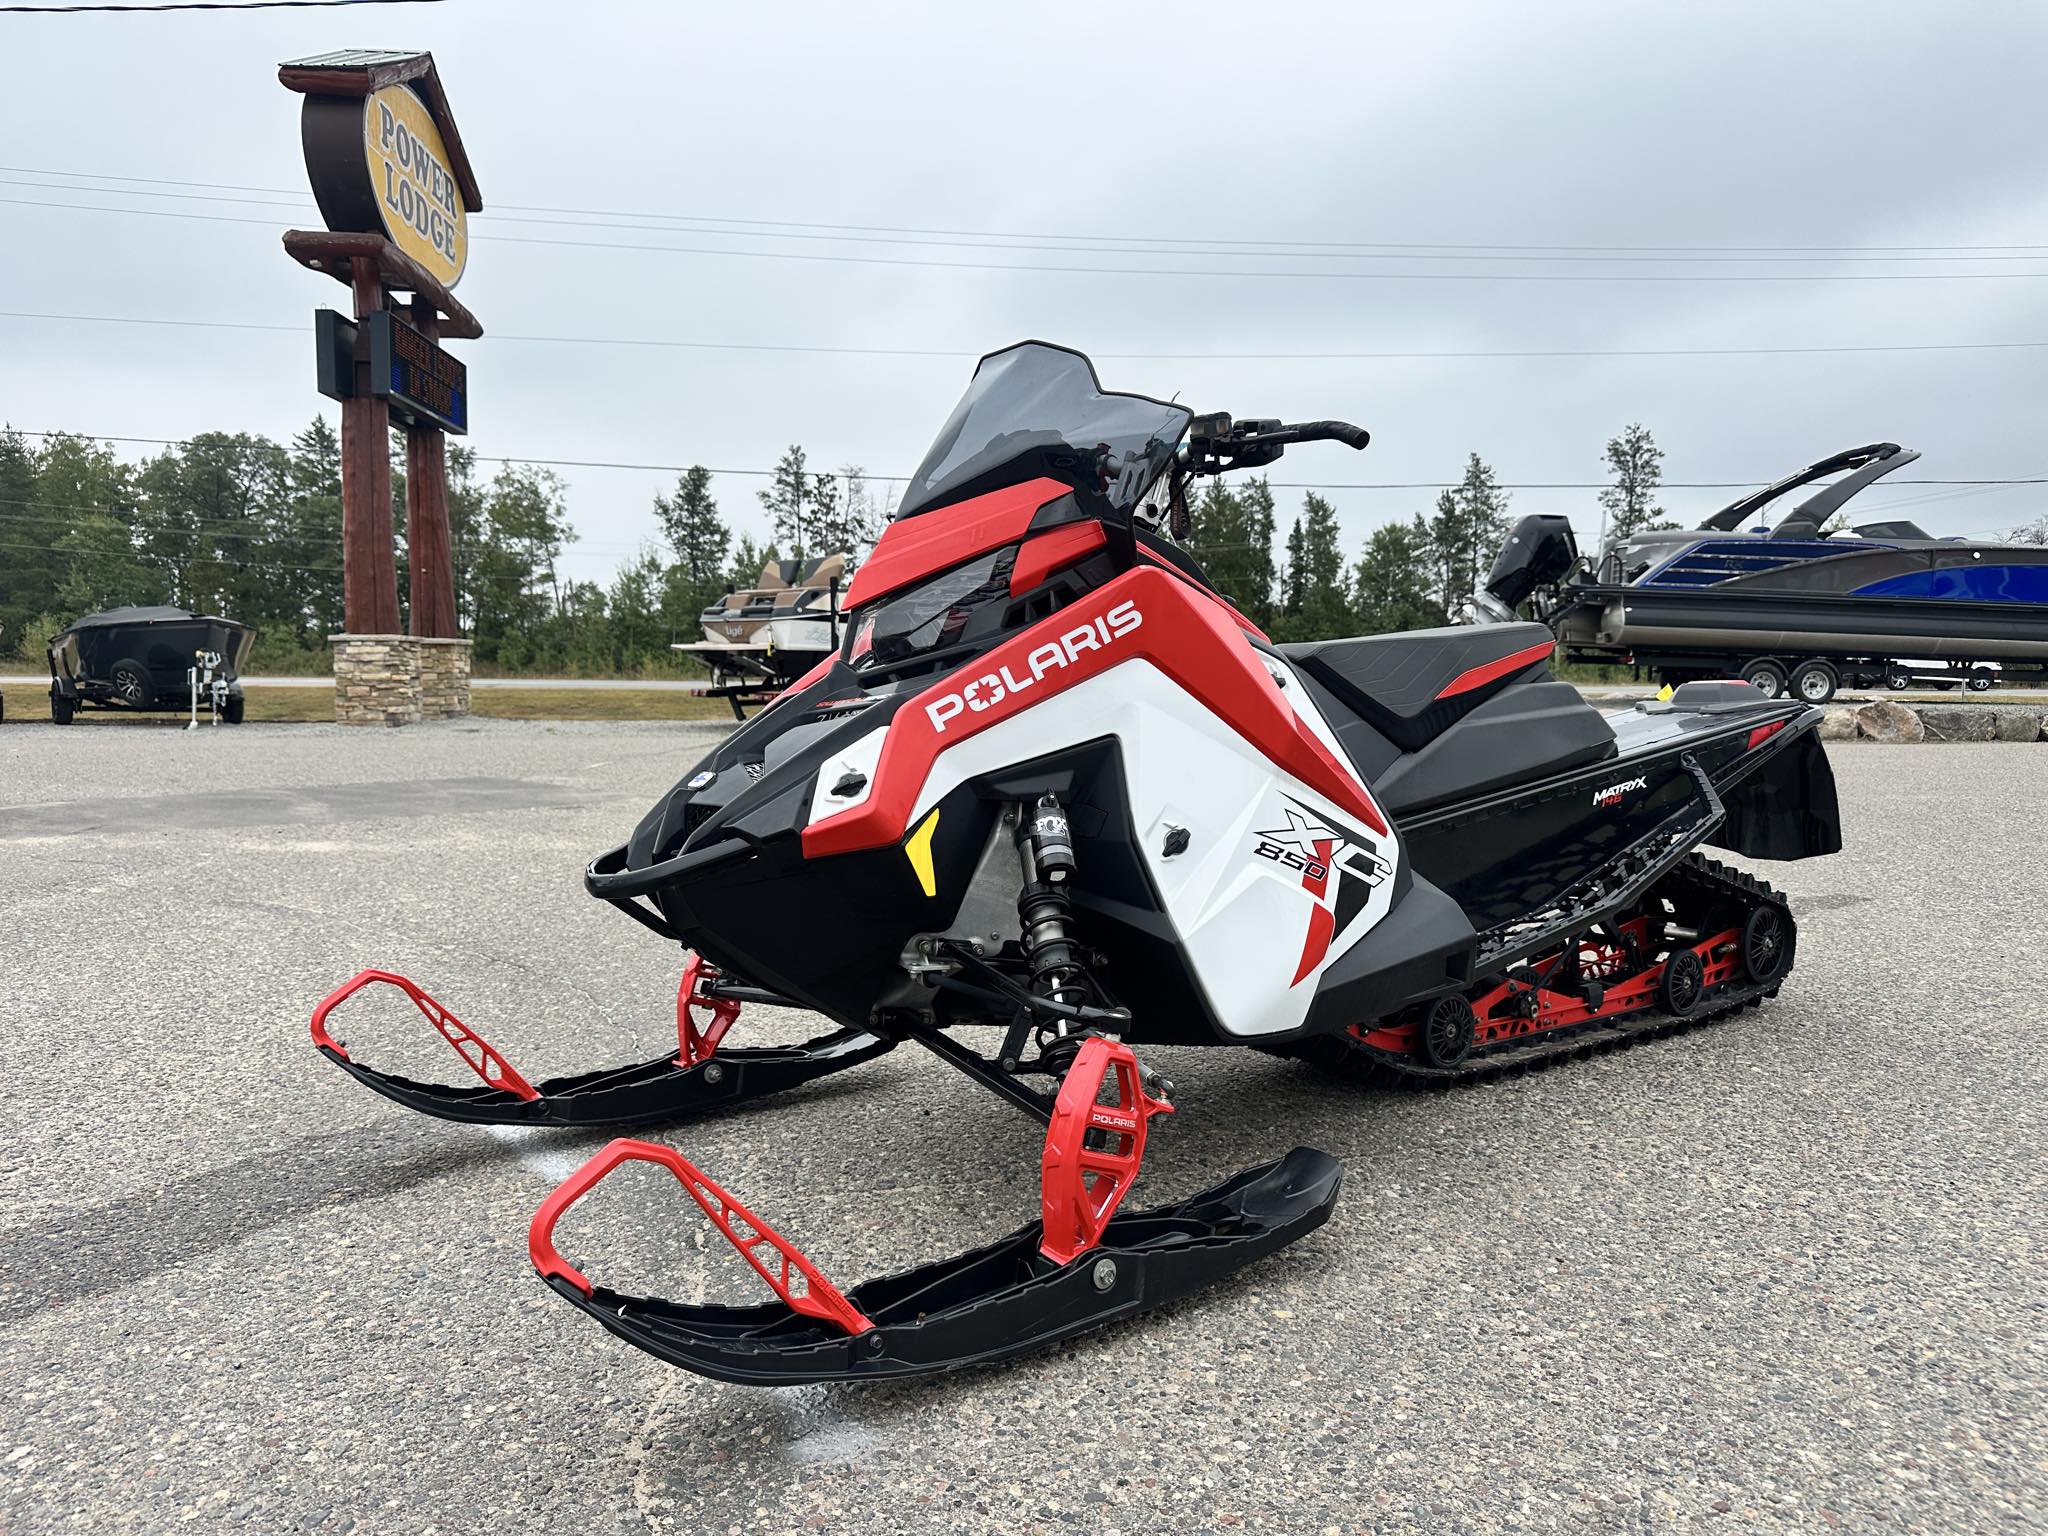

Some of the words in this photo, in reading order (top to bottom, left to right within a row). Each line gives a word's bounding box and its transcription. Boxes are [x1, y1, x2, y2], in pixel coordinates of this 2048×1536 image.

[379, 102, 457, 220] POWER
[385, 161, 456, 263] LODGE
[925, 600, 1143, 733] POLARIS
[1592, 775, 1648, 806] MATRYX
[1035, 816, 1068, 836] FOX
[1252, 808, 1393, 888] XC
[1253, 841, 1327, 881] 850
[1092, 1113, 1136, 1128] POLARIS
[809, 1268, 854, 1316] POLARIS
